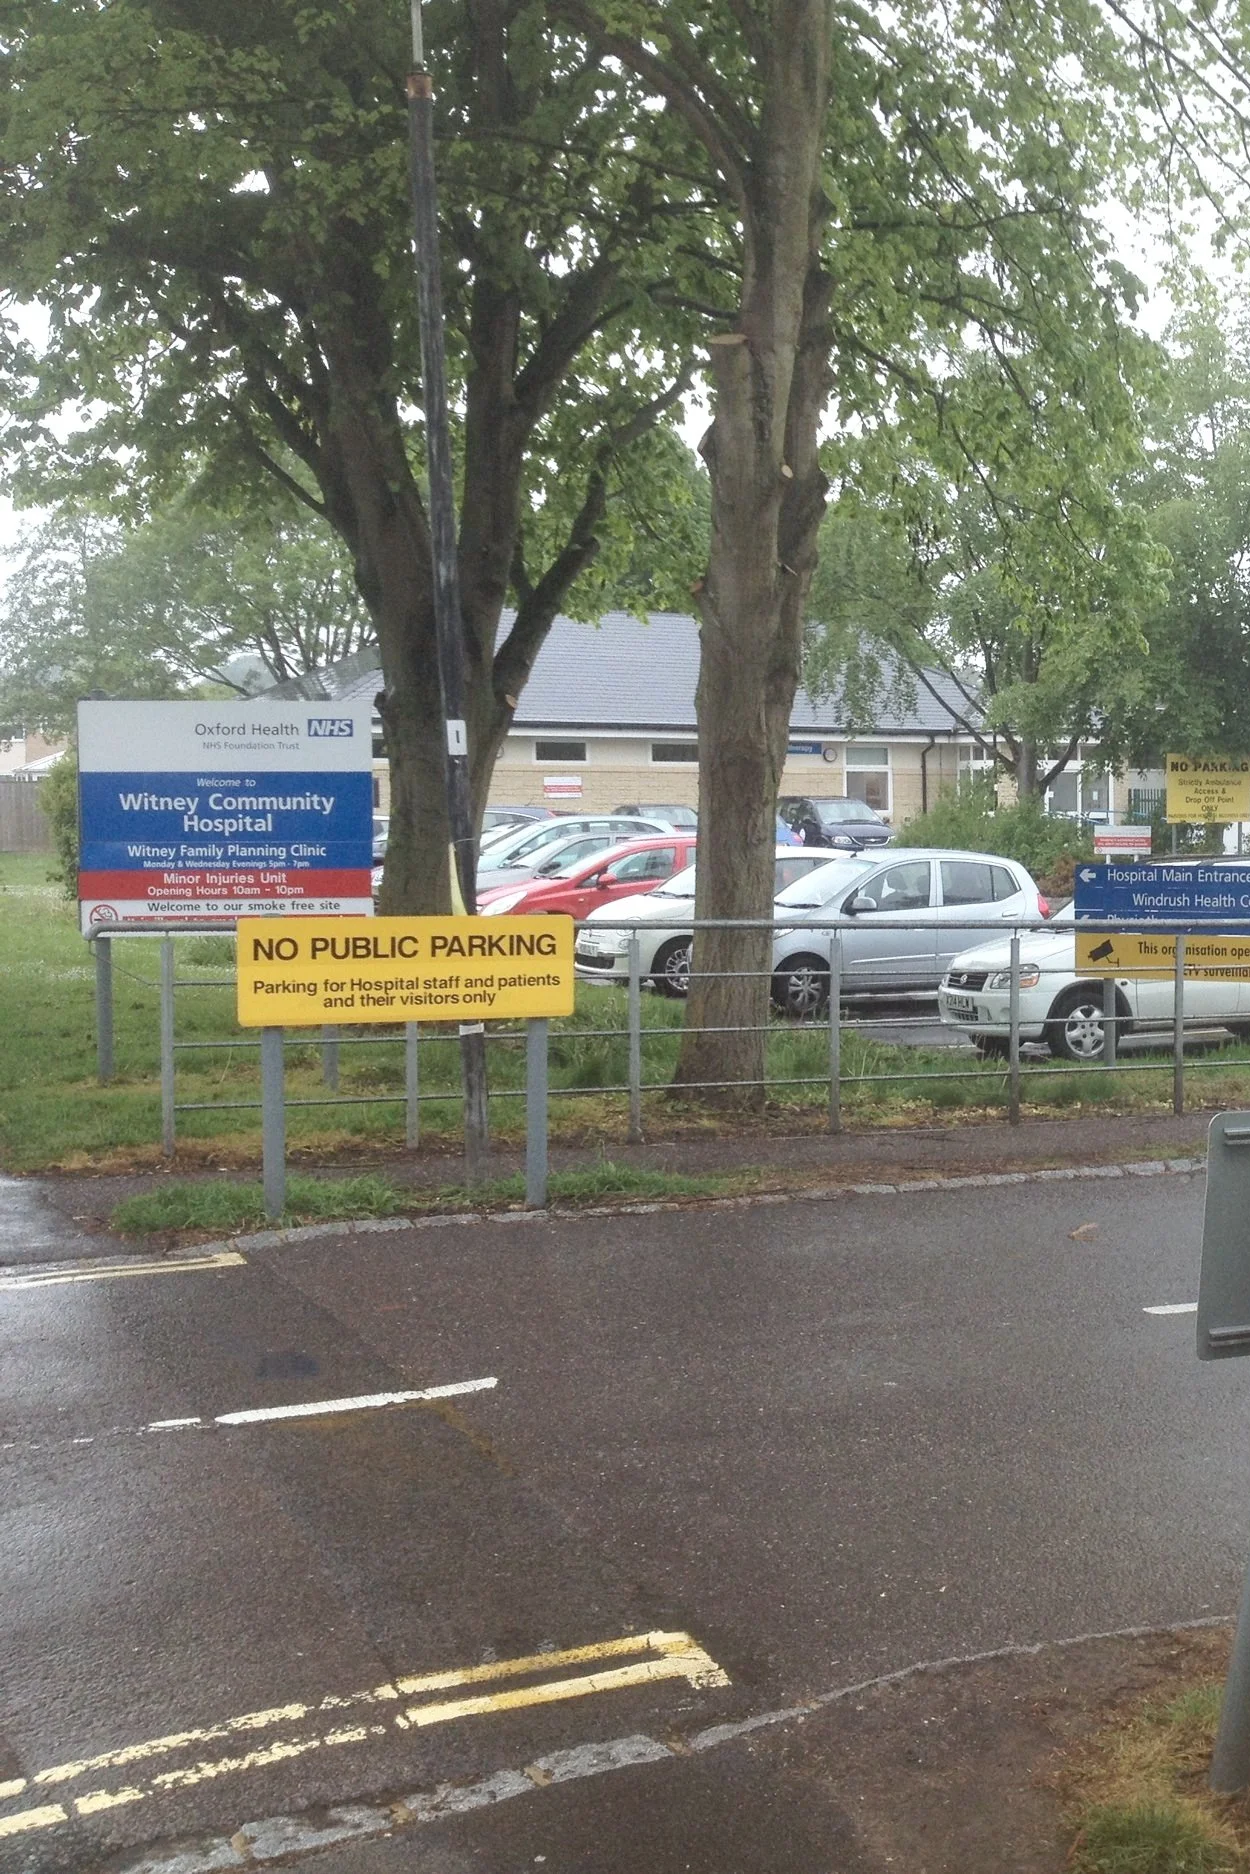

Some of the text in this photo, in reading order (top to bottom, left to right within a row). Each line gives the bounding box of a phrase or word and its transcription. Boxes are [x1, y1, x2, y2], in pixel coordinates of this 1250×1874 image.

[195, 720, 351, 736] Oxford Health NHS
[203, 742, 300, 750] NHS Foundation Trust
[1171, 761, 1188, 772] NO
[197, 778, 257, 788] Welcome to
[119, 792, 335, 815] Witney Community
[183, 814, 273, 836] Hospital
[128, 845, 327, 859] Witney Family Planning Clinic
[144, 861, 175, 869] Monday
[185, 861, 230, 869] Wednesday
[232, 861, 267, 869] Evenings
[269, 861, 286, 869] 5pm
[293, 861, 310, 869] 7pm
[164, 873, 287, 885] Minor Injuries Unit
[1107, 870, 1157, 884] Hospital
[1162, 870, 1193, 882] Main
[147, 886, 192, 896] Opening
[196, 886, 228, 895] Hours
[232, 886, 260, 895] 10am
[276, 886, 304, 896] 10pm
[147, 901, 341, 912] Welcome to our smoke free site
[1133, 893, 1190, 907] Windrush
[1195, 894, 1235, 907] Health
[252, 937, 298, 961] NO
[311, 935, 419, 960] PUBLIC
[431, 934, 557, 958] PARKING
[1138, 941, 1158, 955] This
[1162, 942, 1227, 960] orgnisation
[253, 973, 561, 995] Parking for Hospital staff and patients
[323, 991, 496, 1008] and their visitors only
